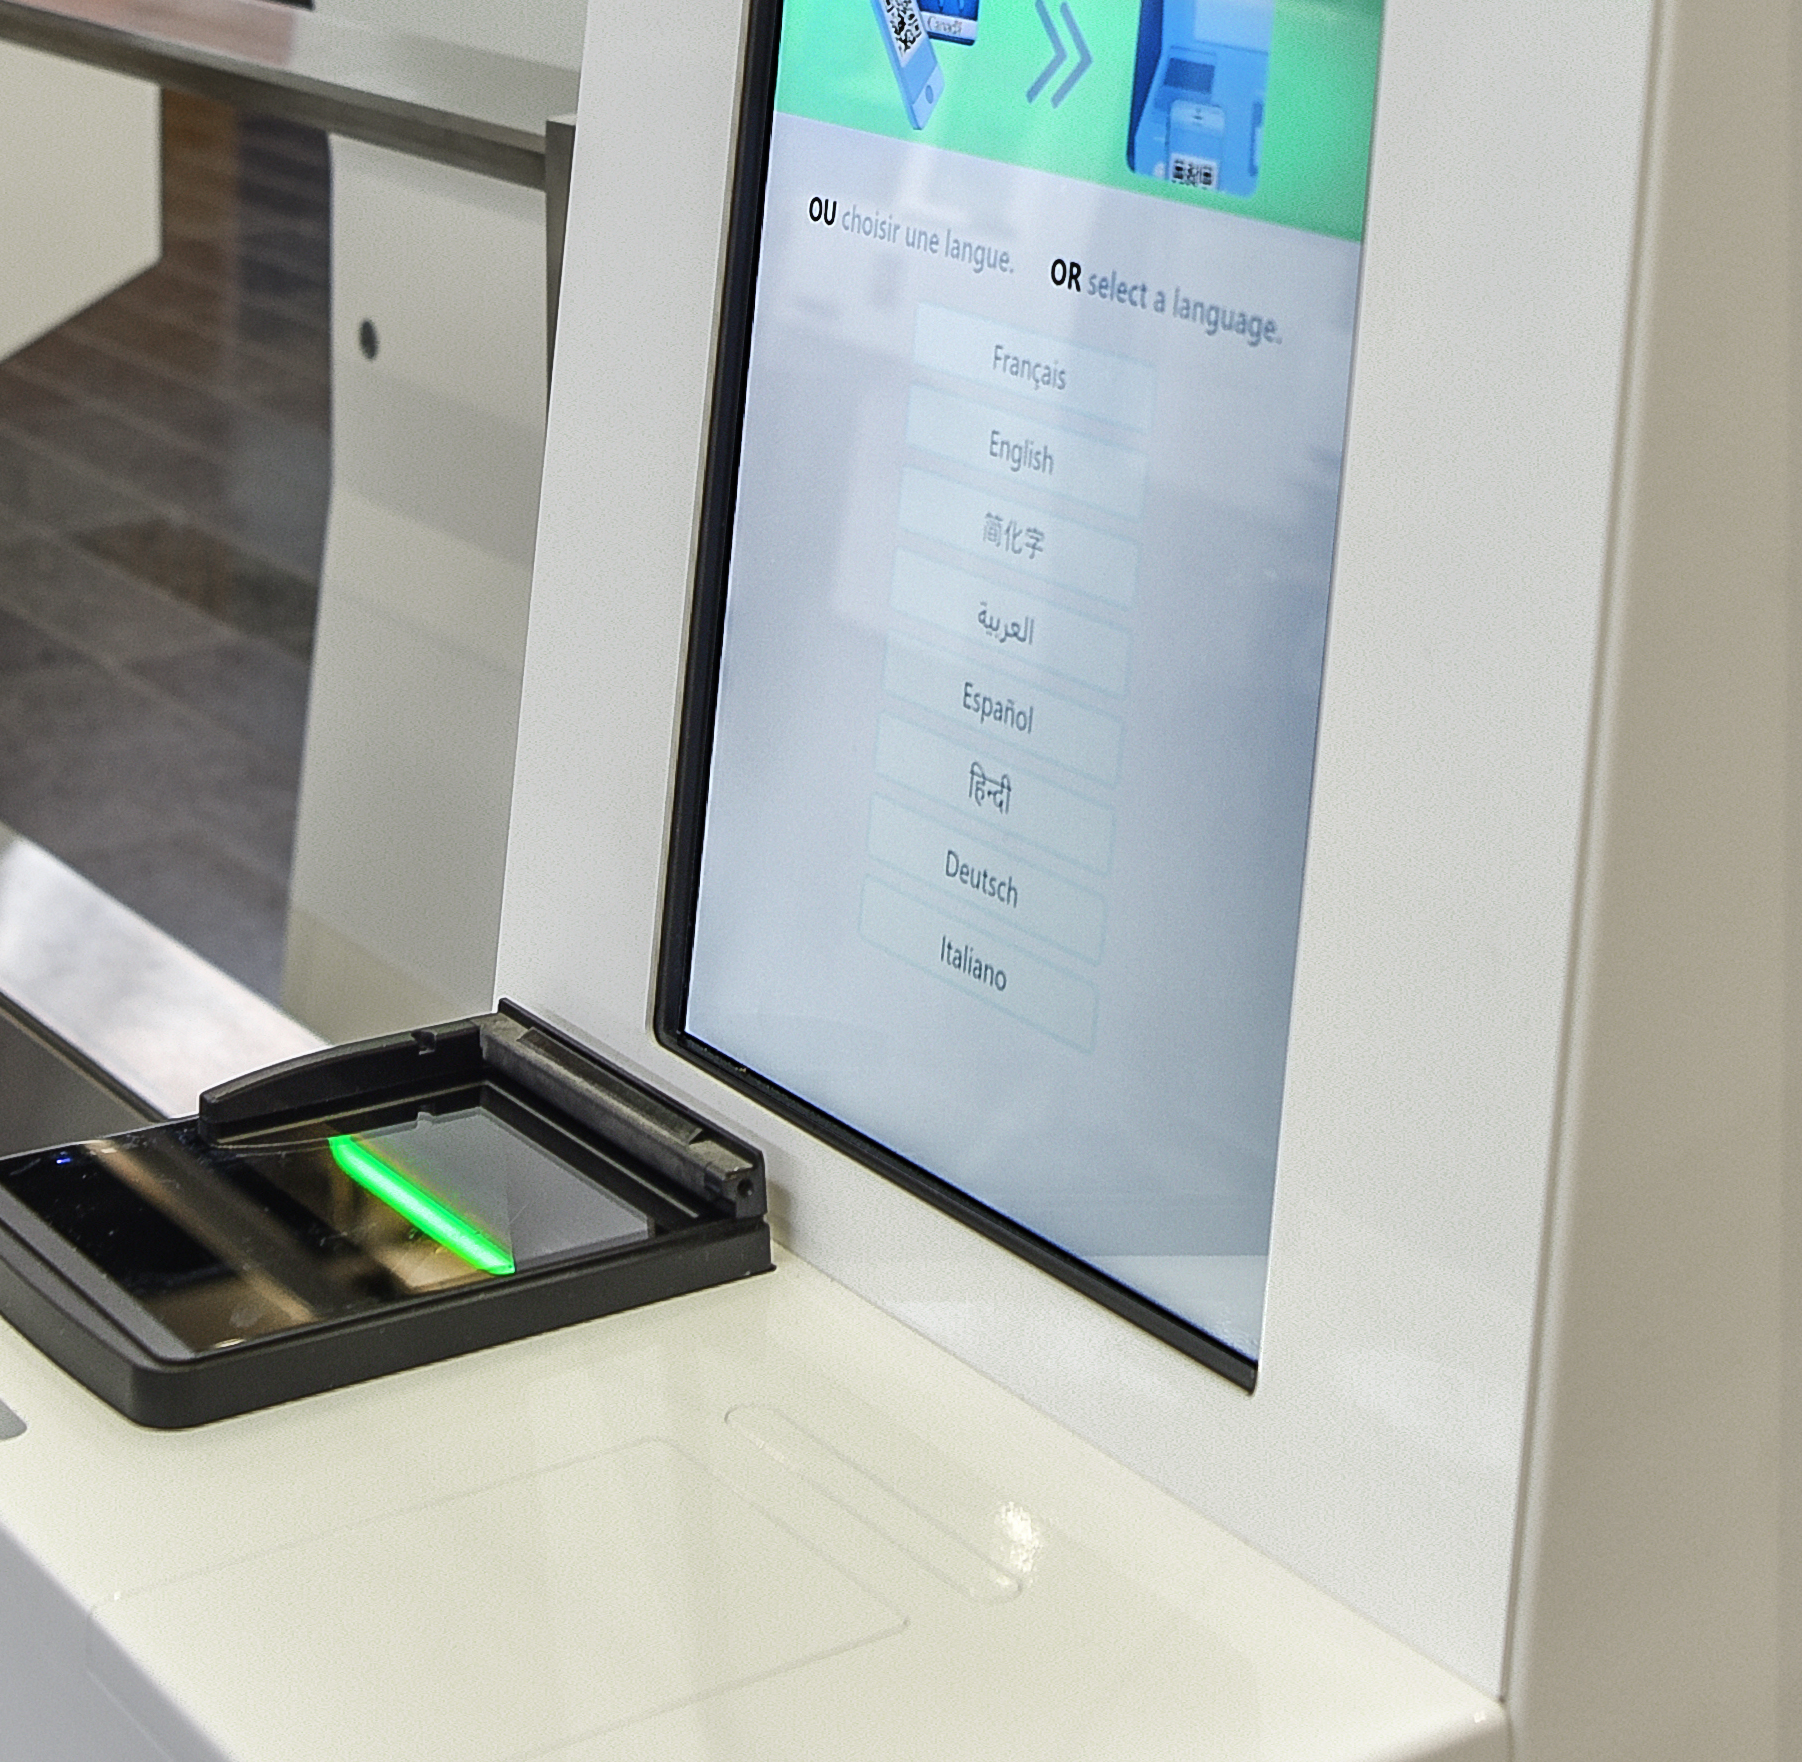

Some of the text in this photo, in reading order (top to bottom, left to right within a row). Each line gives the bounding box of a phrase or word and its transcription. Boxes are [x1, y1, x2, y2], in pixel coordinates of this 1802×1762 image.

[809, 196, 1014, 274] OU choisir une langue.
[1051, 258, 1283, 347] OR select a language.
[993, 344, 1066, 390] Français
[989, 430, 1054, 475] English
[983, 511, 1045, 559] 简化字
[978, 601, 1034, 645] العربية
[963, 682, 1033, 734] Español
[969, 761, 1011, 814] हिन्दी
[946, 850, 1018, 908] Deutsch
[941, 935, 1007, 991] Italiano
